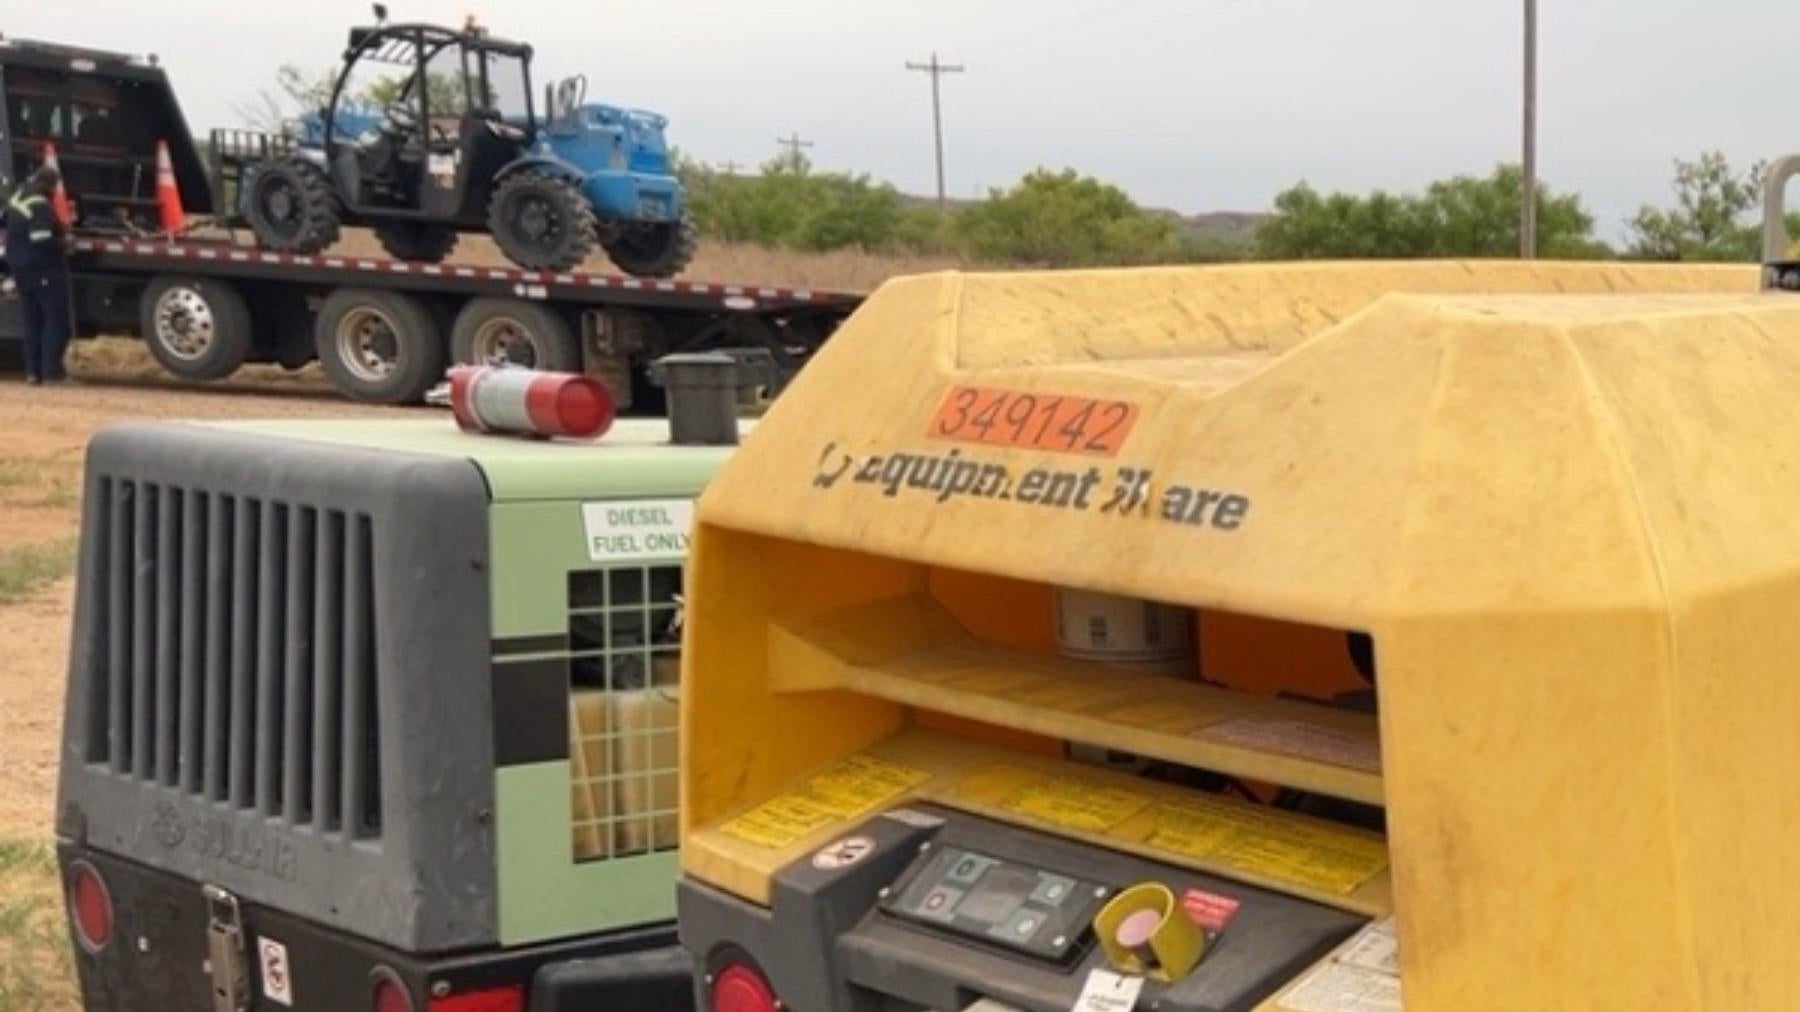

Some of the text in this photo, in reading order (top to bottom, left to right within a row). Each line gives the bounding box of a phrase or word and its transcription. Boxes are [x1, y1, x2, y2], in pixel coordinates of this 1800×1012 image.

[938, 386, 1130, 452] 349142
[607, 507, 673, 526] DIESEL
[593, 534, 641, 554] FUEL
